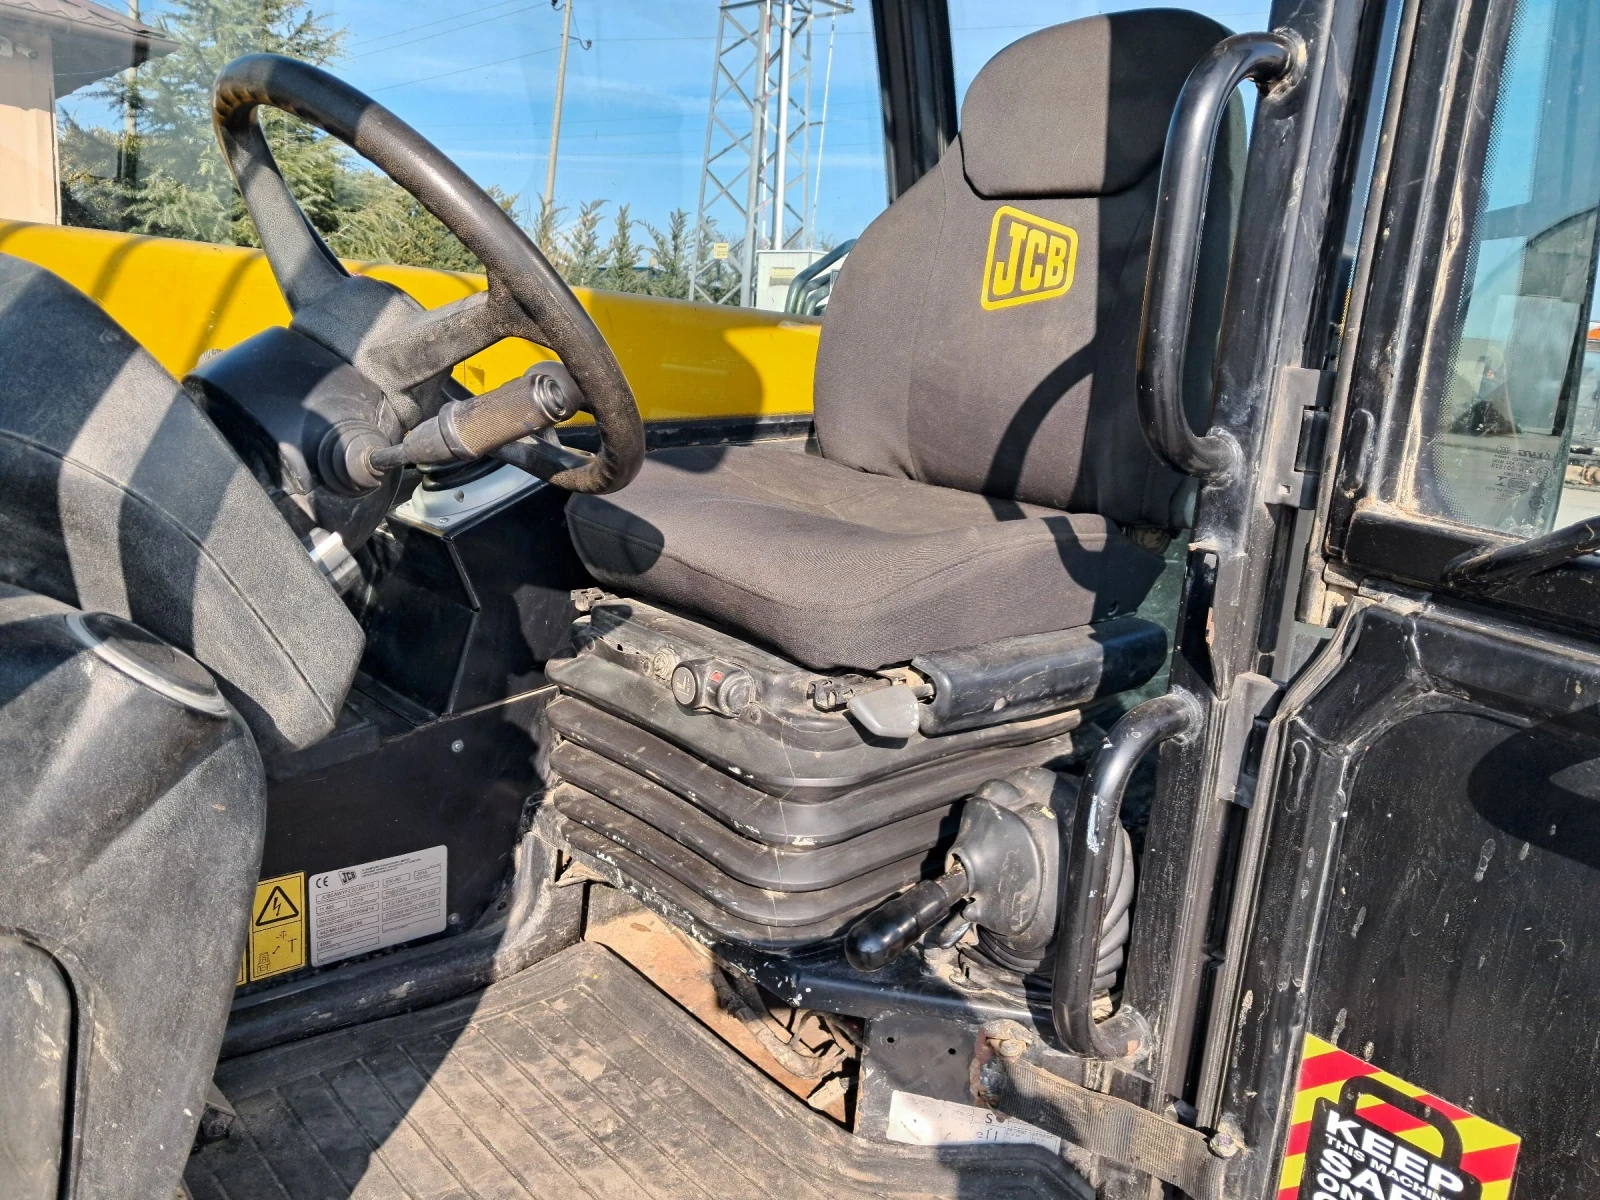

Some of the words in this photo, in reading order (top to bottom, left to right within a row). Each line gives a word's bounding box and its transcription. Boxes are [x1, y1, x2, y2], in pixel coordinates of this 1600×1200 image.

[993, 222, 1068, 296] JCB
[1325, 1134, 1366, 1162] THIS
[1326, 1110, 1464, 1192] KEEP
[1317, 1172, 1362, 1200] ON
